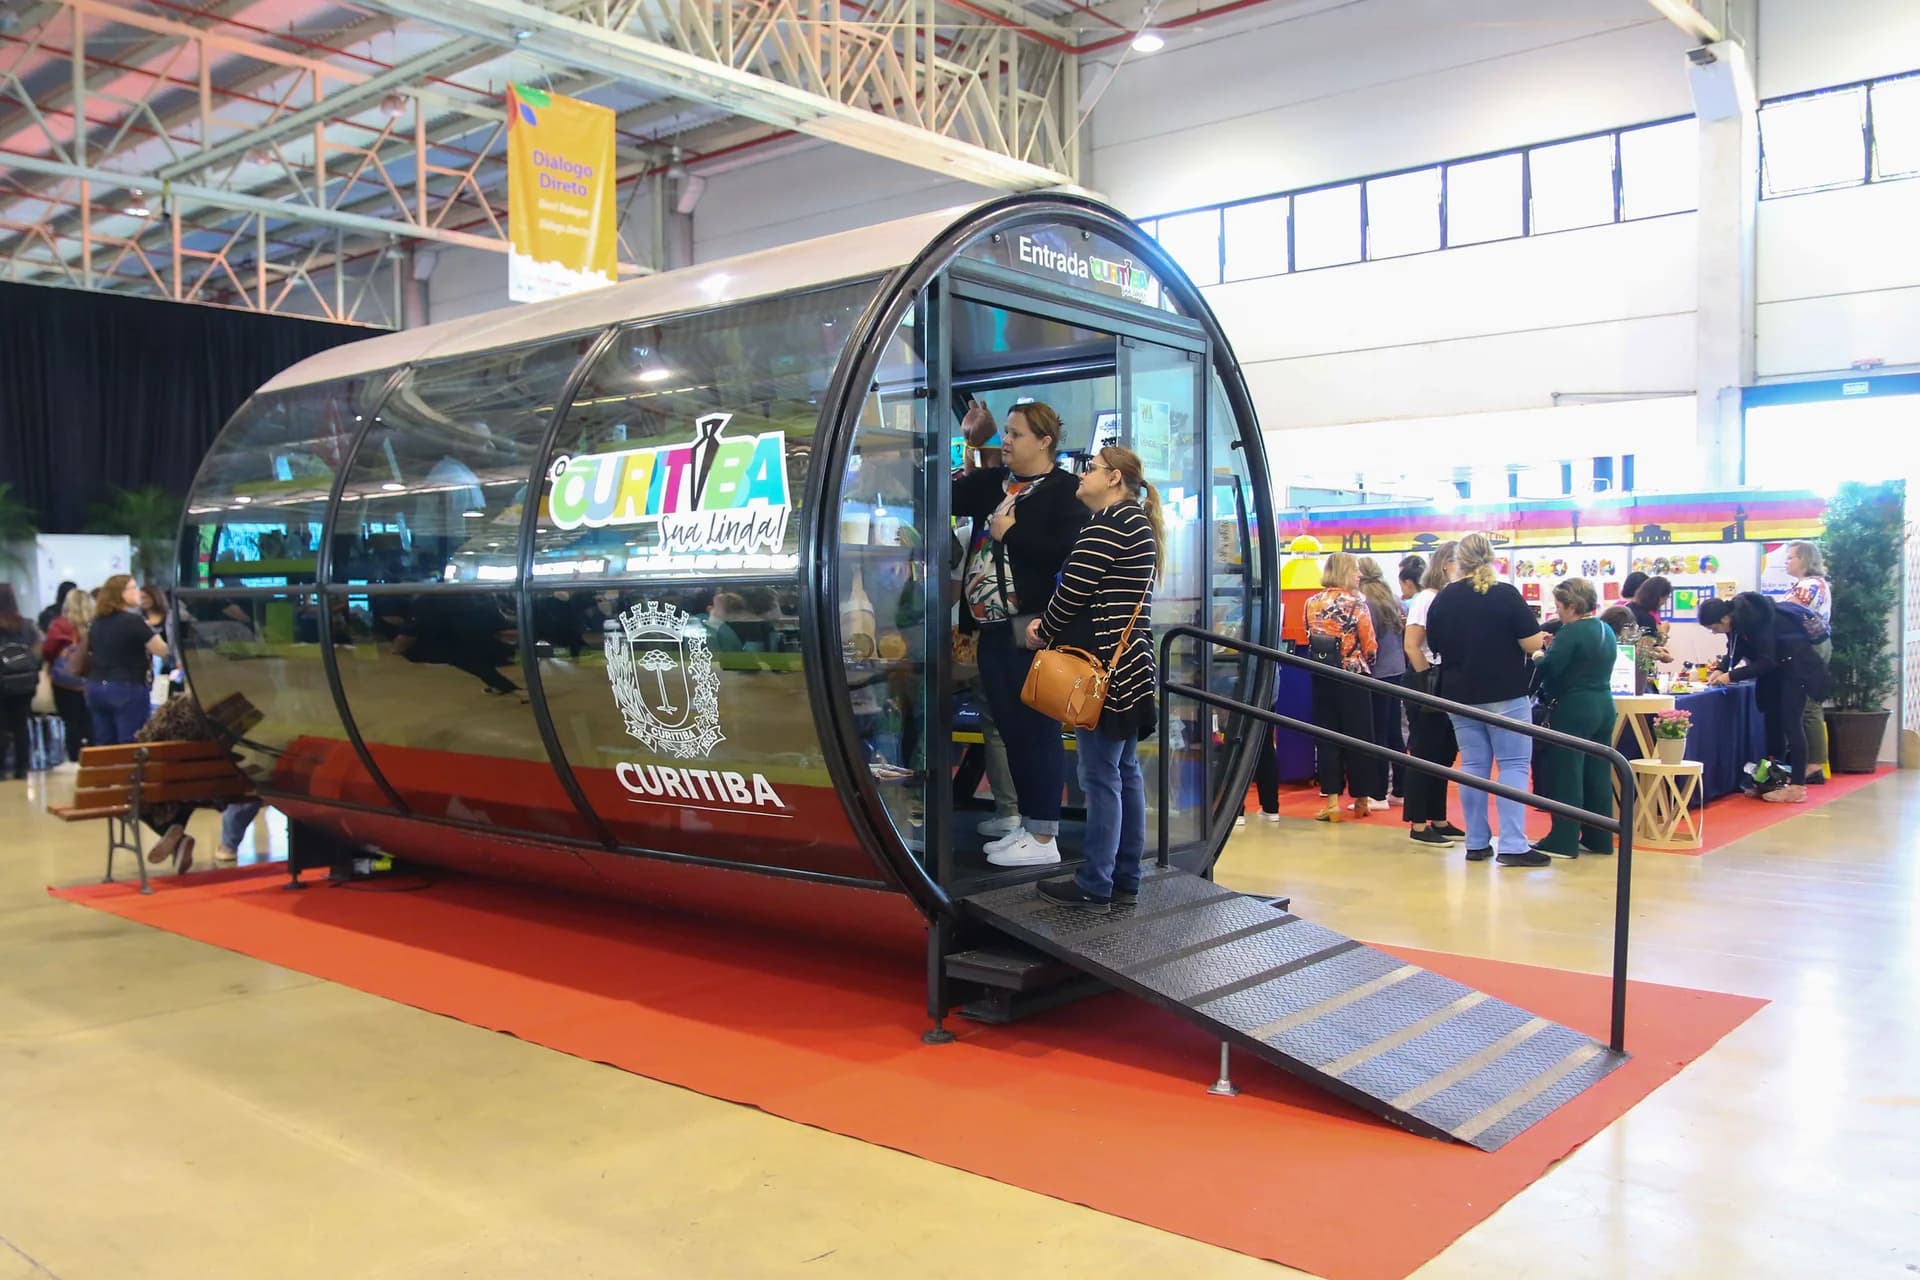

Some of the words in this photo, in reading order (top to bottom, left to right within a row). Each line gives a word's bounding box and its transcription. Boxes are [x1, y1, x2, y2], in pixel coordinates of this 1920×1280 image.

[540, 171, 587, 196] Direto
[1019, 235, 1089, 279] Entrada
[661, 515, 702, 551] Sua
[706, 506, 785, 548] Linda!
[1581, 559, 1616, 577] NA
[1632, 554, 1719, 575] MASSA
[650, 727, 698, 741] CURITIBA
[615, 761, 785, 808] CURITIBA
